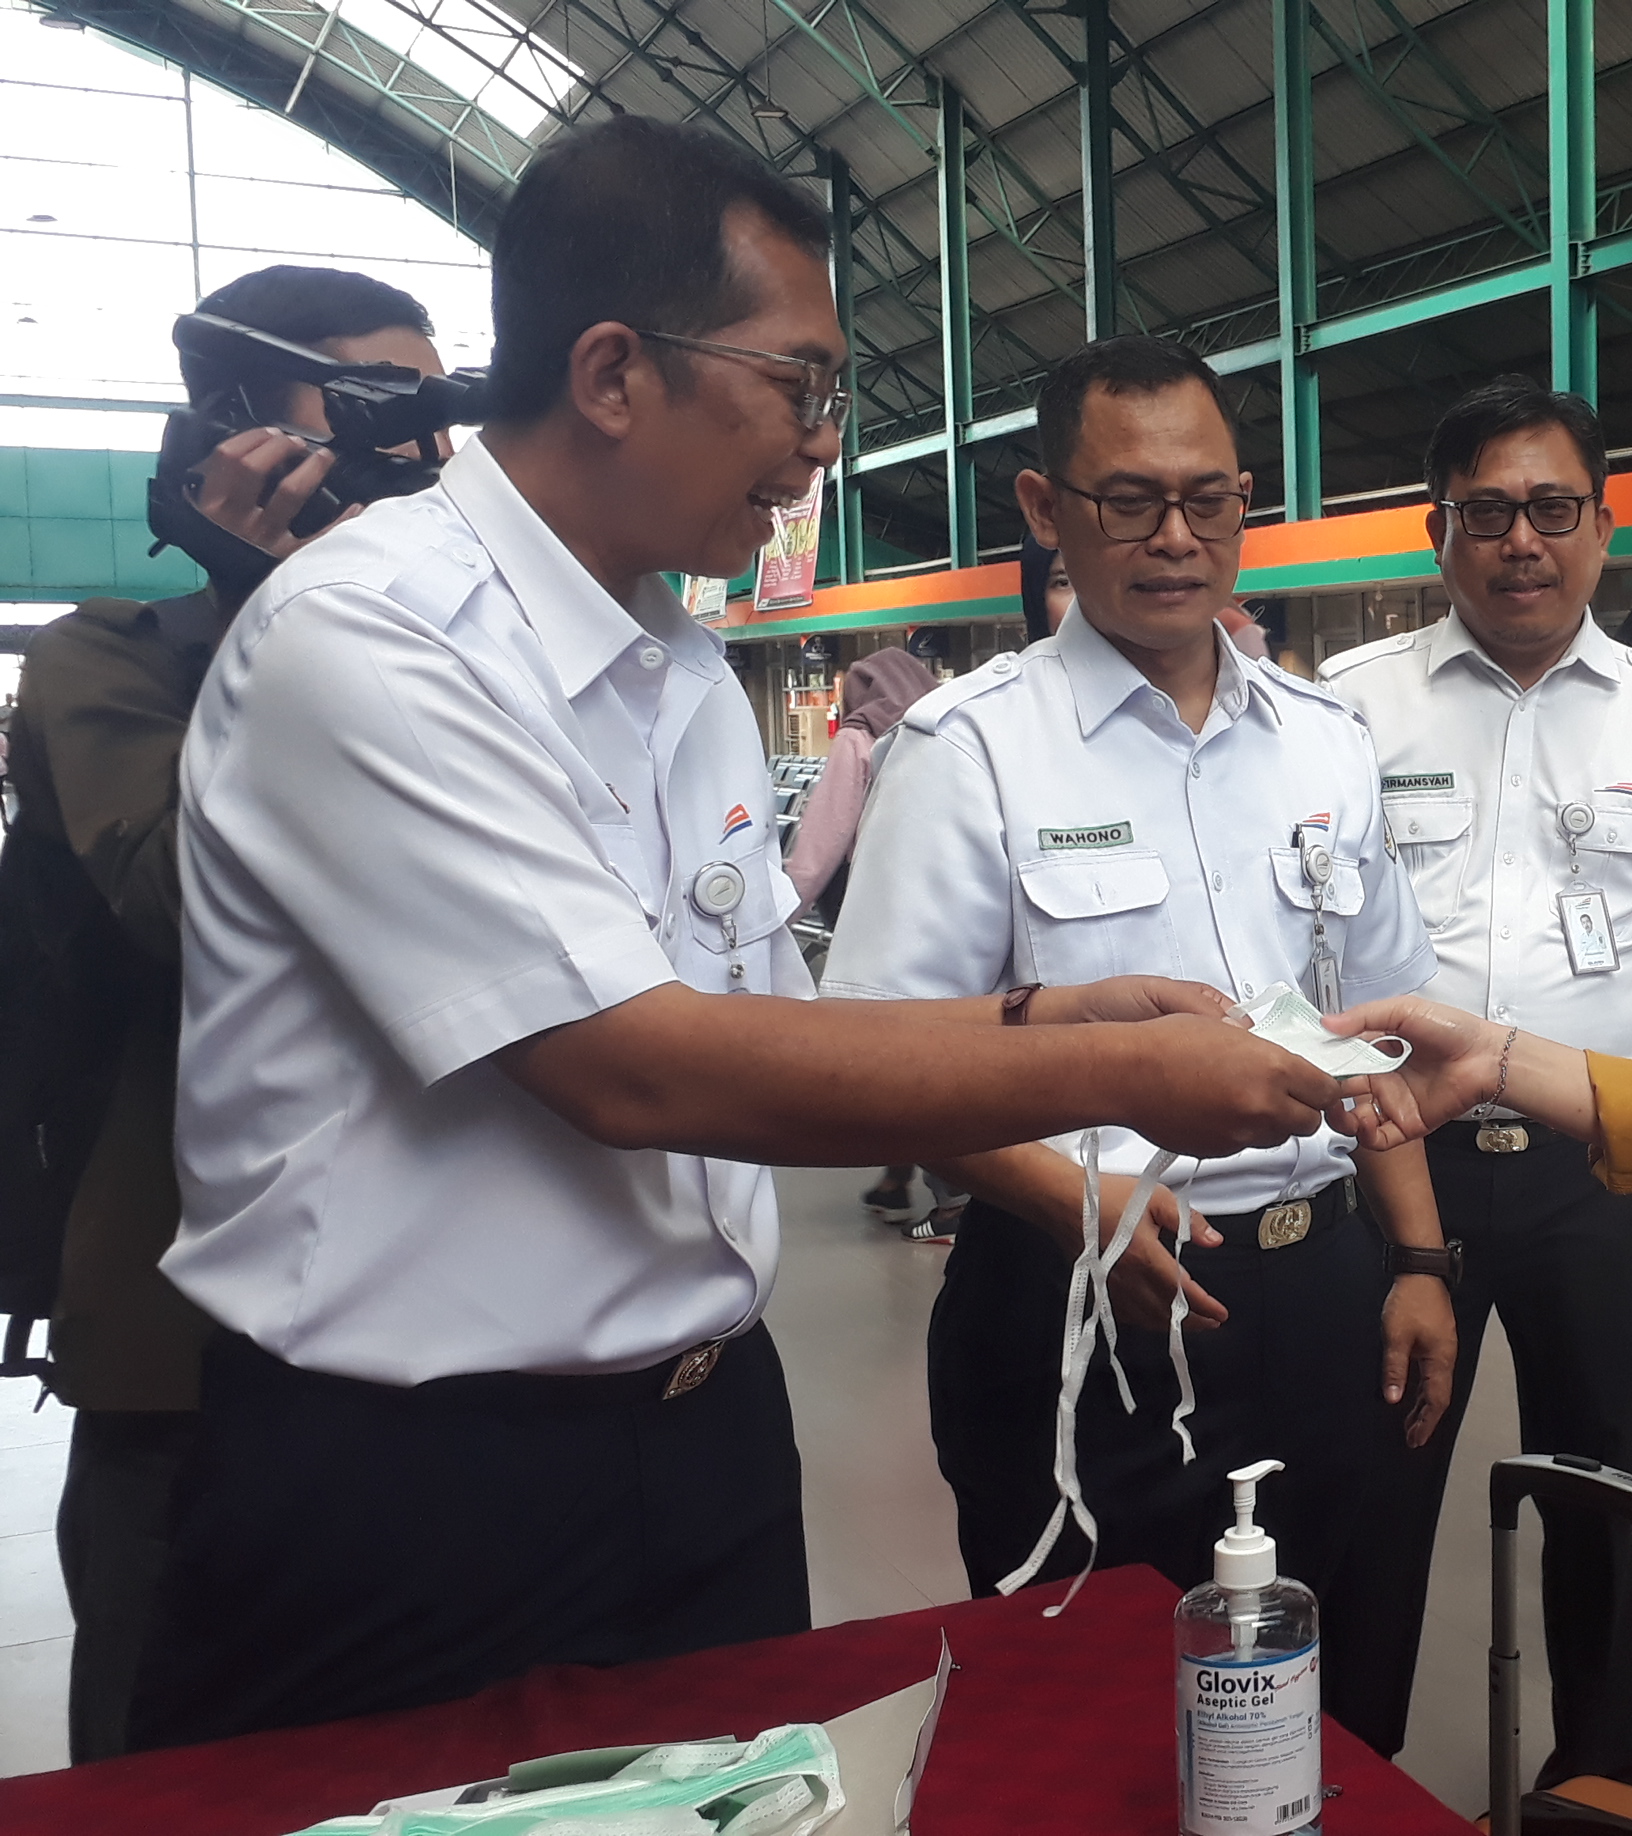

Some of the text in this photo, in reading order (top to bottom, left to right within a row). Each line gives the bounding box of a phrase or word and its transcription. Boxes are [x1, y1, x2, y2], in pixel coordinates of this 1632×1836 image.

[1050, 829, 1121, 846] WAHONO
[1197, 1670, 1275, 1694] Glovix
[1197, 1693, 1274, 1711] Aseptic Gel
[1216, 1713, 1247, 1721] Alkohol
[1250, 1712, 1267, 1720] 70%
